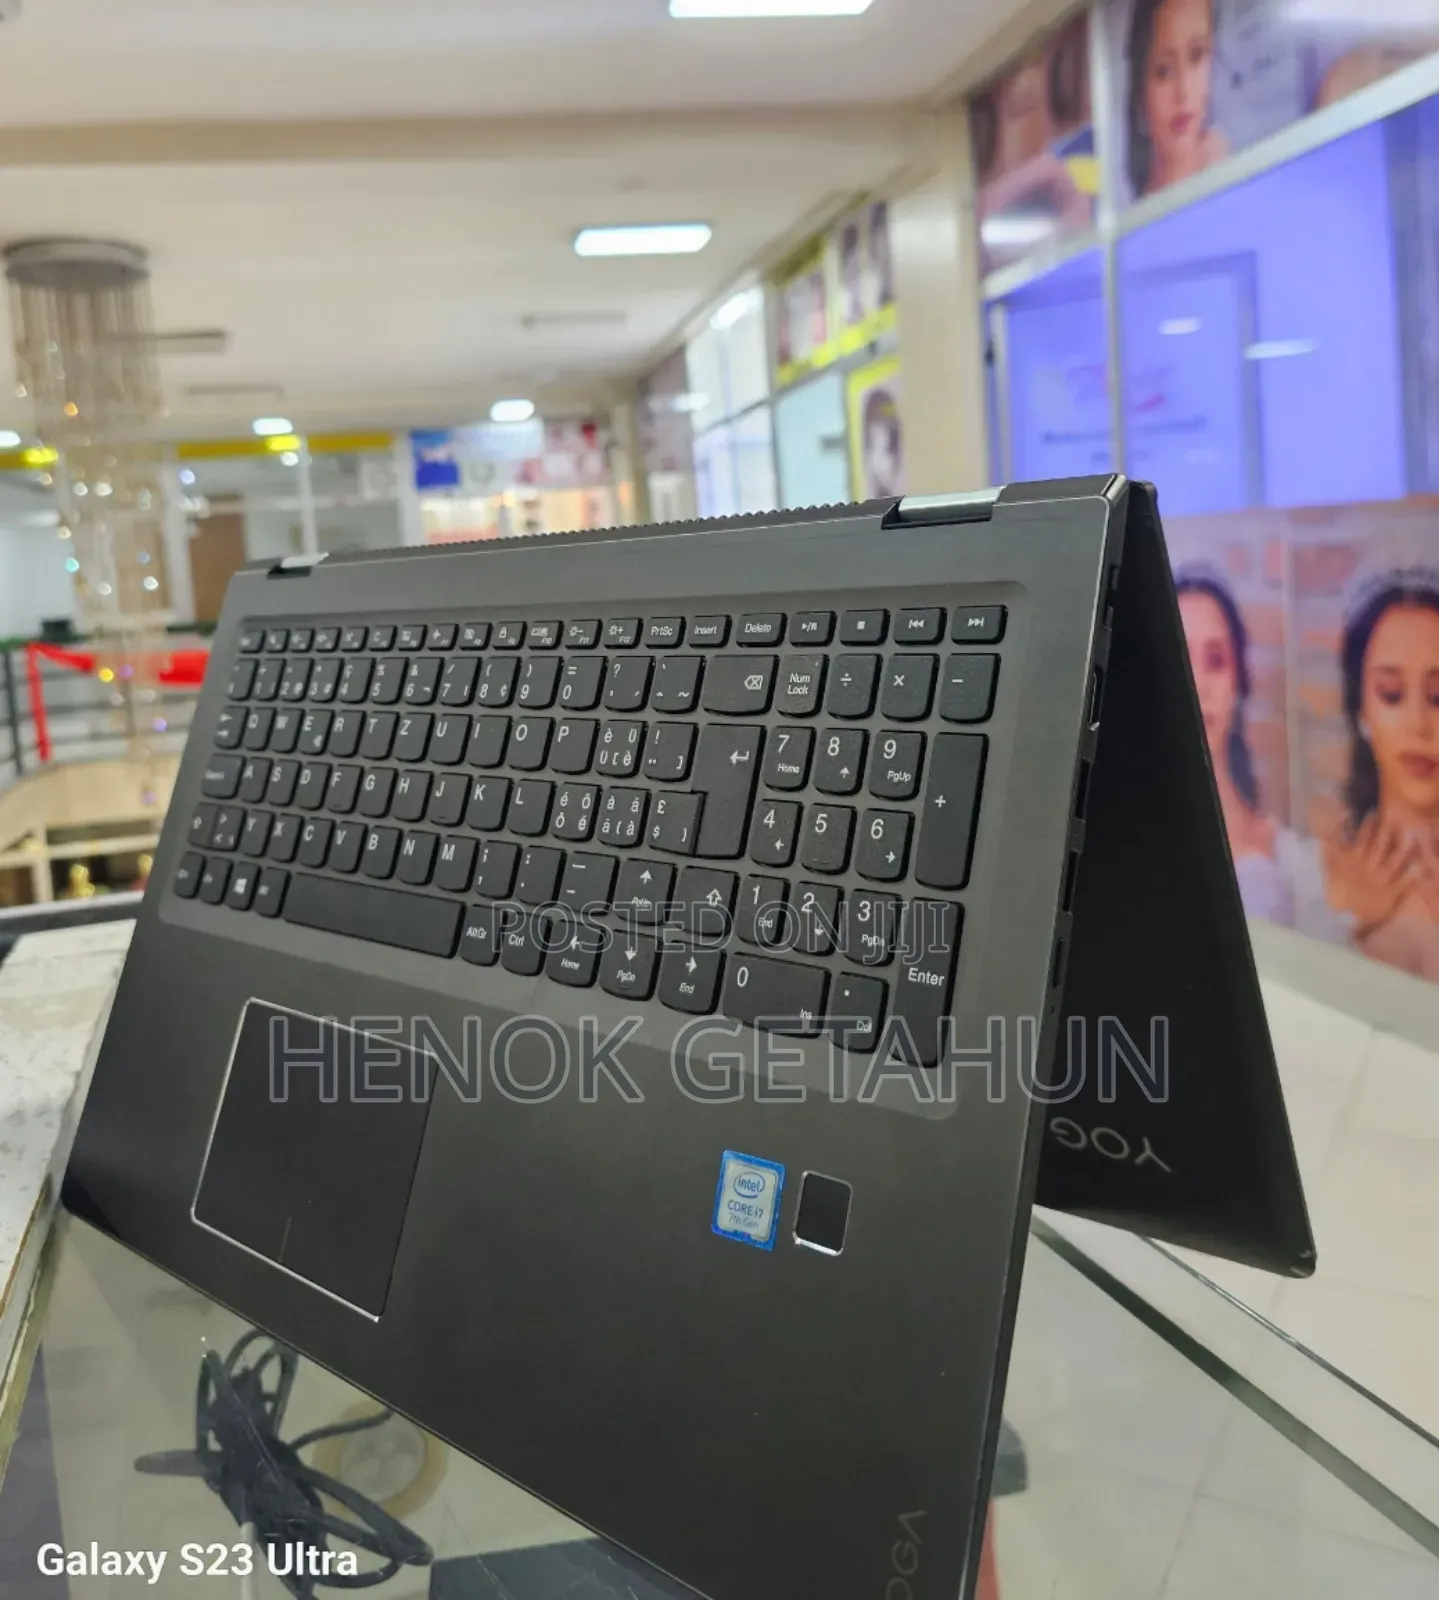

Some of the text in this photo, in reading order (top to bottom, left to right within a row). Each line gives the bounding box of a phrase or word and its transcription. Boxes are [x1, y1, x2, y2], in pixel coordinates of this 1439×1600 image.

[650, 626, 673, 636] PrtSc
[694, 625, 718, 635] Insert
[744, 623, 772, 633] Delete
[411, 664, 418, 676] &
[486, 663, 492, 677] (
[526, 664, 533, 677] )
[567, 666, 577, 675] =
[613, 663, 621, 678] ?
[789, 673, 811, 683] Num
[281, 682, 290, 695] 2
[340, 682, 349, 696] 4
[372, 683, 381, 696] 5
[406, 683, 415, 697] 6
[442, 683, 451, 697] 7
[479, 683, 489, 698] 8
[520, 684, 530, 699] 9
[562, 684, 572, 700] 0
[787, 684, 809, 695] Lock
[276, 715, 290, 730] W
[303, 716, 315, 731] E
[333, 717, 345, 732] R
[368, 718, 378, 733] T
[400, 719, 412, 736] Z
[436, 721, 448, 737] U
[474, 723, 481, 739] I
[515, 724, 528, 741] O
[557, 726, 570, 743] P
[604, 728, 613, 743] è
[655, 729, 661, 745] !
[777, 734, 790, 753] 7
[827, 736, 840, 757] 8
[882, 739, 897, 760] 9
[612, 752, 619, 766] [
[676, 756, 684, 770] ]
[244, 765, 254, 779] A
[271, 766, 283, 782] S
[777, 763, 800, 773] Home
[300, 769, 312, 785] D
[331, 771, 343, 787] F
[365, 774, 376, 791] G
[886, 770, 912, 783] PgUp
[398, 777, 411, 794] H
[435, 780, 446, 797] J
[474, 784, 486, 801] K
[515, 787, 524, 805] L
[935, 795, 947, 808] +
[656, 800, 667, 814] £
[247, 817, 257, 831] Y
[763, 809, 776, 828] 4
[814, 813, 828, 833] 5
[273, 821, 285, 836] X
[304, 825, 315, 841] C
[652, 824, 661, 839] $
[870, 819, 884, 840] 6
[336, 829, 347, 845] V
[368, 833, 379, 850] B
[403, 839, 416, 856] N
[441, 843, 456, 861] M
[752, 885, 761, 904] 1
[801, 892, 815, 913] 2
[857, 900, 871, 922] 3
[758, 917, 773, 928] End
[466, 926, 488, 940] AltGr
[508, 934, 525, 947] Ctrl
[861, 934, 885, 947] PgDn
[561, 958, 581, 970] Home
[616, 970, 636, 983] PgDn
[736, 966, 749, 987] 0
[907, 967, 945, 986] Enter
[679, 983, 695, 994] End
[800, 1008, 812, 1019] Ins
[738, 1177, 761, 1193] intel
[727, 1199, 764, 1219] CORE i7
[729, 1212, 760, 1230] 7th Gen
